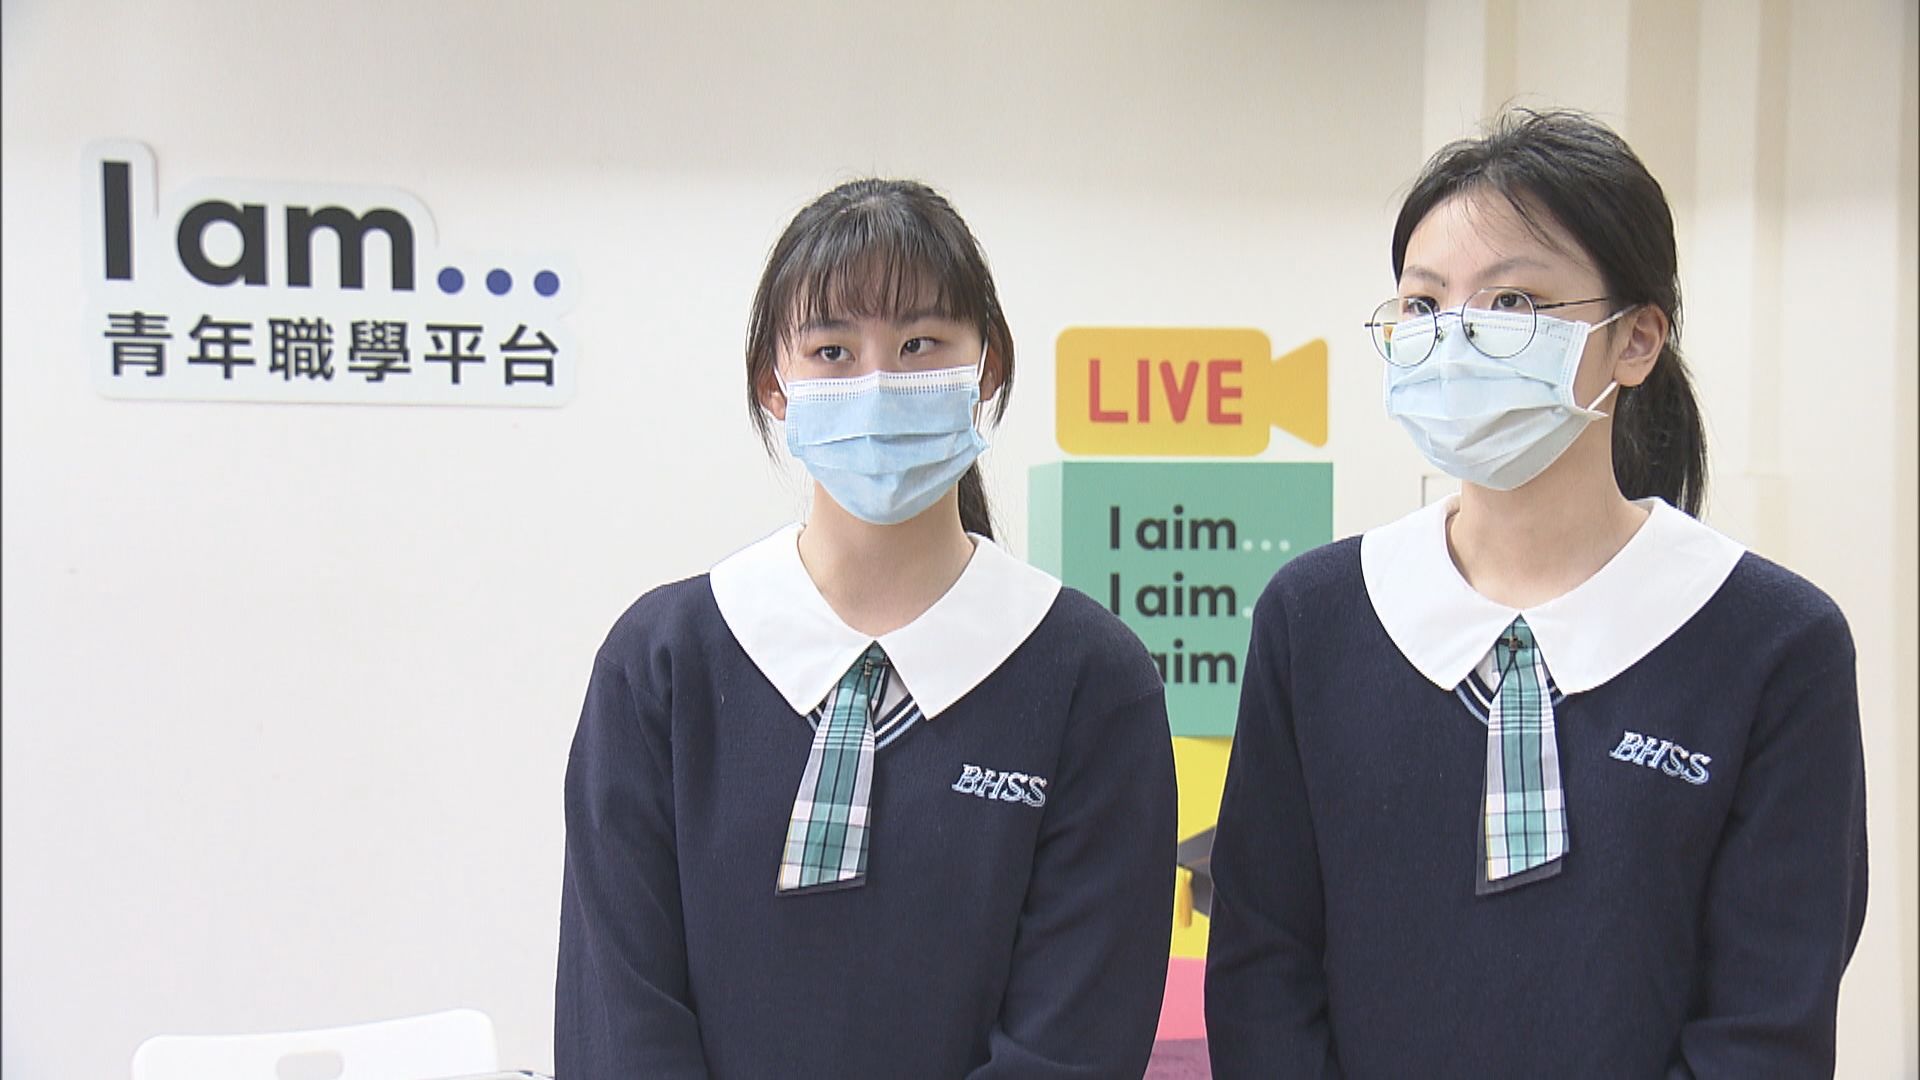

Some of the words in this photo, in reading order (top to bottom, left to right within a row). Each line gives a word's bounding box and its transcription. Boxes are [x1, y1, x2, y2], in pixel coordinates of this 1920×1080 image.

[101, 160, 132, 281] I
[103, 311, 560, 387] 青年職學平台
[1089, 358, 1243, 425] LIVE
[1110, 506, 1121, 550] I
[1110, 573, 1121, 616] I
[951, 763, 1048, 807] BHSS
[1609, 730, 1712, 785] BHSS
